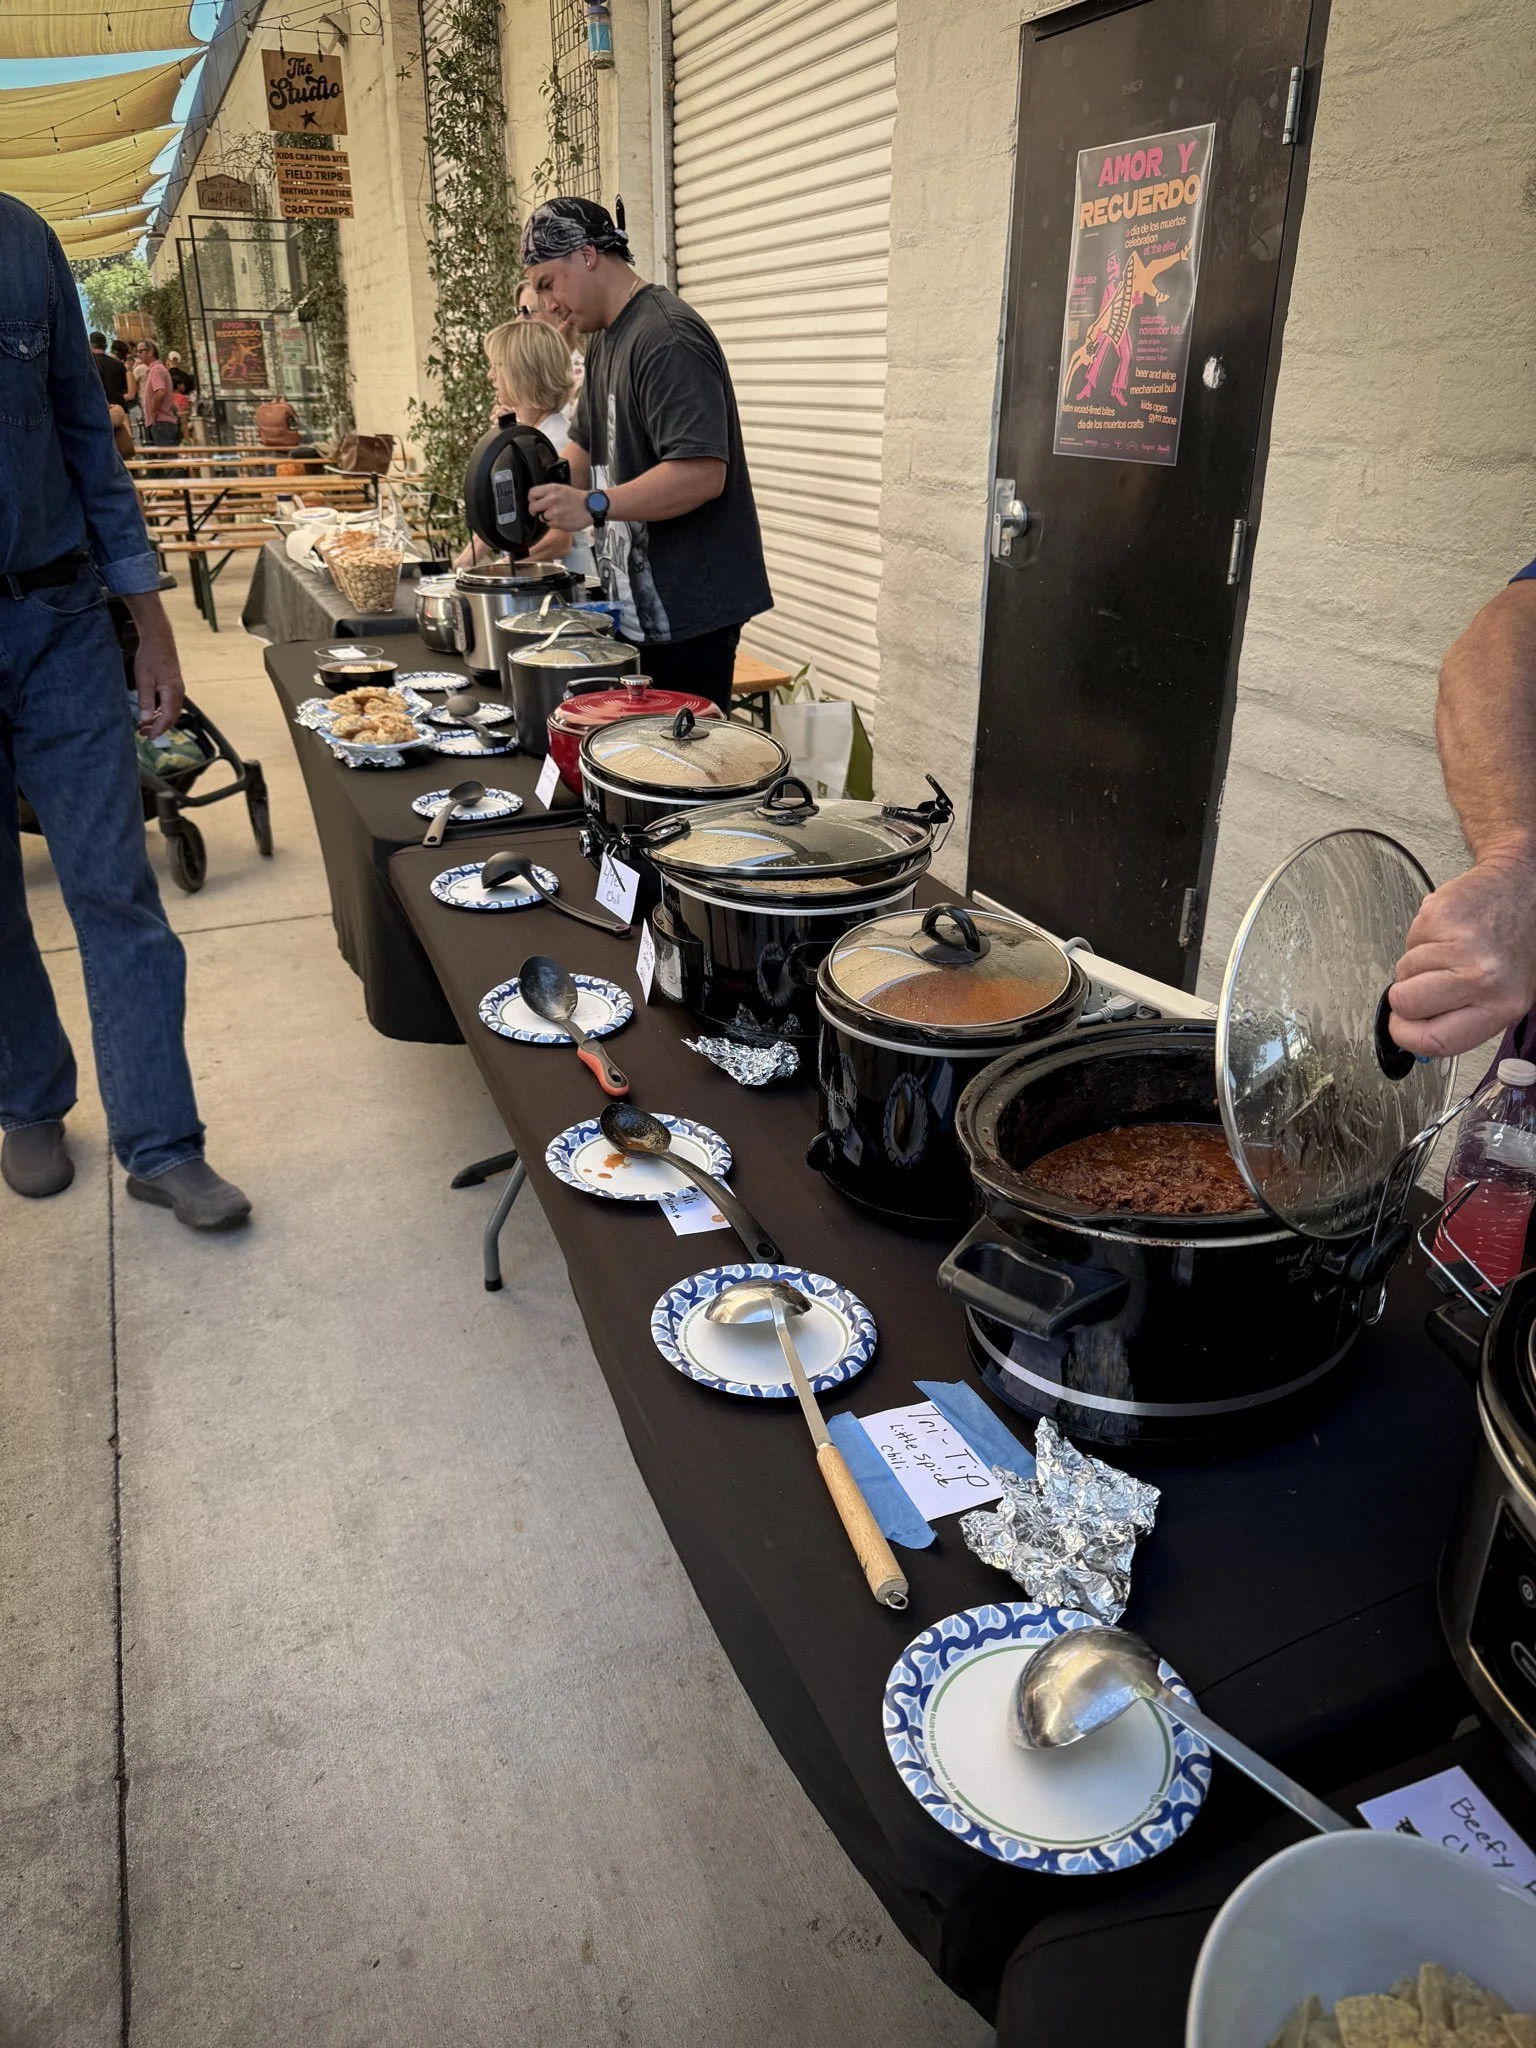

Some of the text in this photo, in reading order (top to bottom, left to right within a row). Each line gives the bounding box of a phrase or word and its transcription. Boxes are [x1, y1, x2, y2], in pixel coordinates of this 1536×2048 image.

[287, 57, 314, 79] The
[269, 75, 342, 110] Studio
[276, 151, 348, 163] KIDS CRAFTING SITE
[1098, 140, 1197, 187] AMOR Y
[285, 169, 344, 181] FIELD TRIPS
[281, 187, 352, 198] BIRTHDAY PARTIES
[1079, 174, 1201, 229] RECUERDO
[285, 205, 351, 216] CRAFT CAMPS
[1141, 223, 1149, 234] de
[1150, 221, 1160, 232] los
[1160, 216, 1187, 230] muertos
[1124, 233, 1158, 249] celebration
[1138, 325, 1170, 335] november
[1135, 367, 1177, 381] beer and wine
[1130, 382, 1177, 395] mechanical bull
[1101, 406, 1116, 417] bites
[1140, 400, 1168, 413] kids open
[1087, 419, 1094, 429] de
[1094, 419, 1103, 429] los
[1103, 419, 1127, 429] muertos
[1127, 418, 1145, 429] crafts
[1148, 413, 1177, 426] gym zone
[930, 1742, 940, 1758] HOME
[947, 1781, 957, 1790] OK
[1450, 1796, 1515, 1868] Beefy
